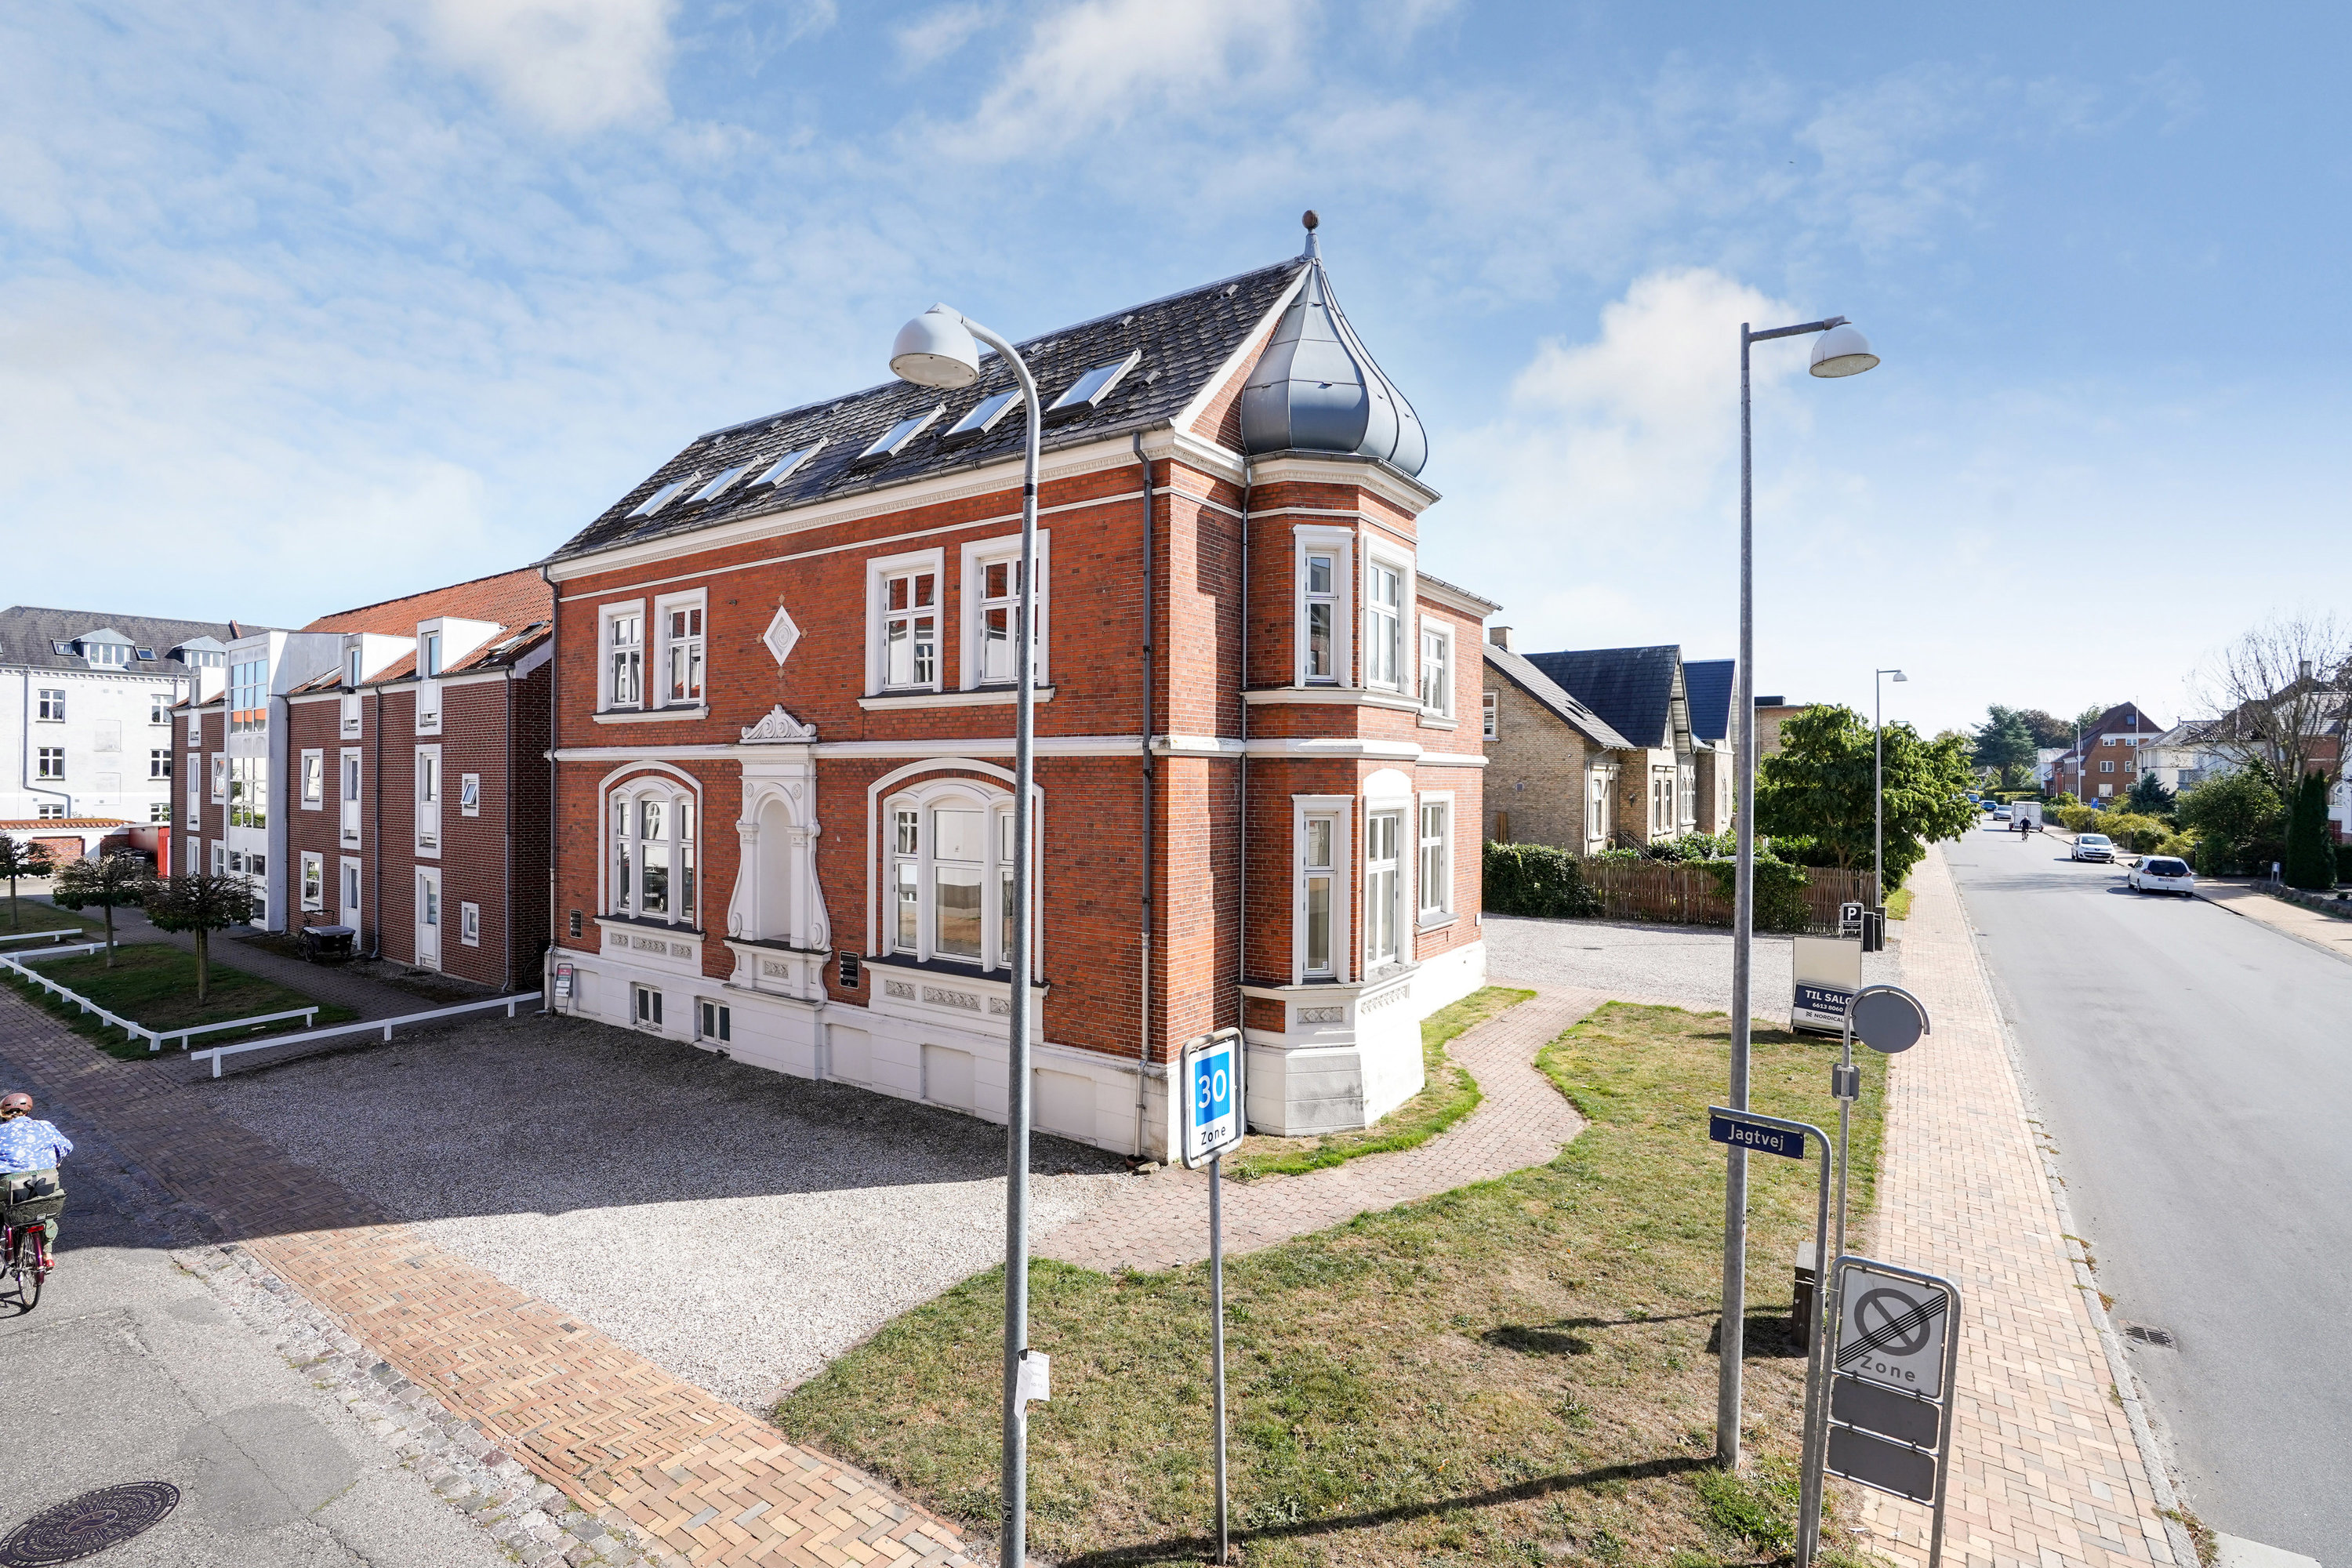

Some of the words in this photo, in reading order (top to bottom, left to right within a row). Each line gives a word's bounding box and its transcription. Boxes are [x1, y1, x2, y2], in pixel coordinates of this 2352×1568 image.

[1848, 907, 1857, 920] P
[1806, 990, 1822, 1000] TIL
[1198, 1069, 1227, 1109] 30
[1201, 1126, 1226, 1145] Zone
[1728, 1123, 1784, 1151] Jagtvej
[1860, 1354, 1915, 1382] Zone
